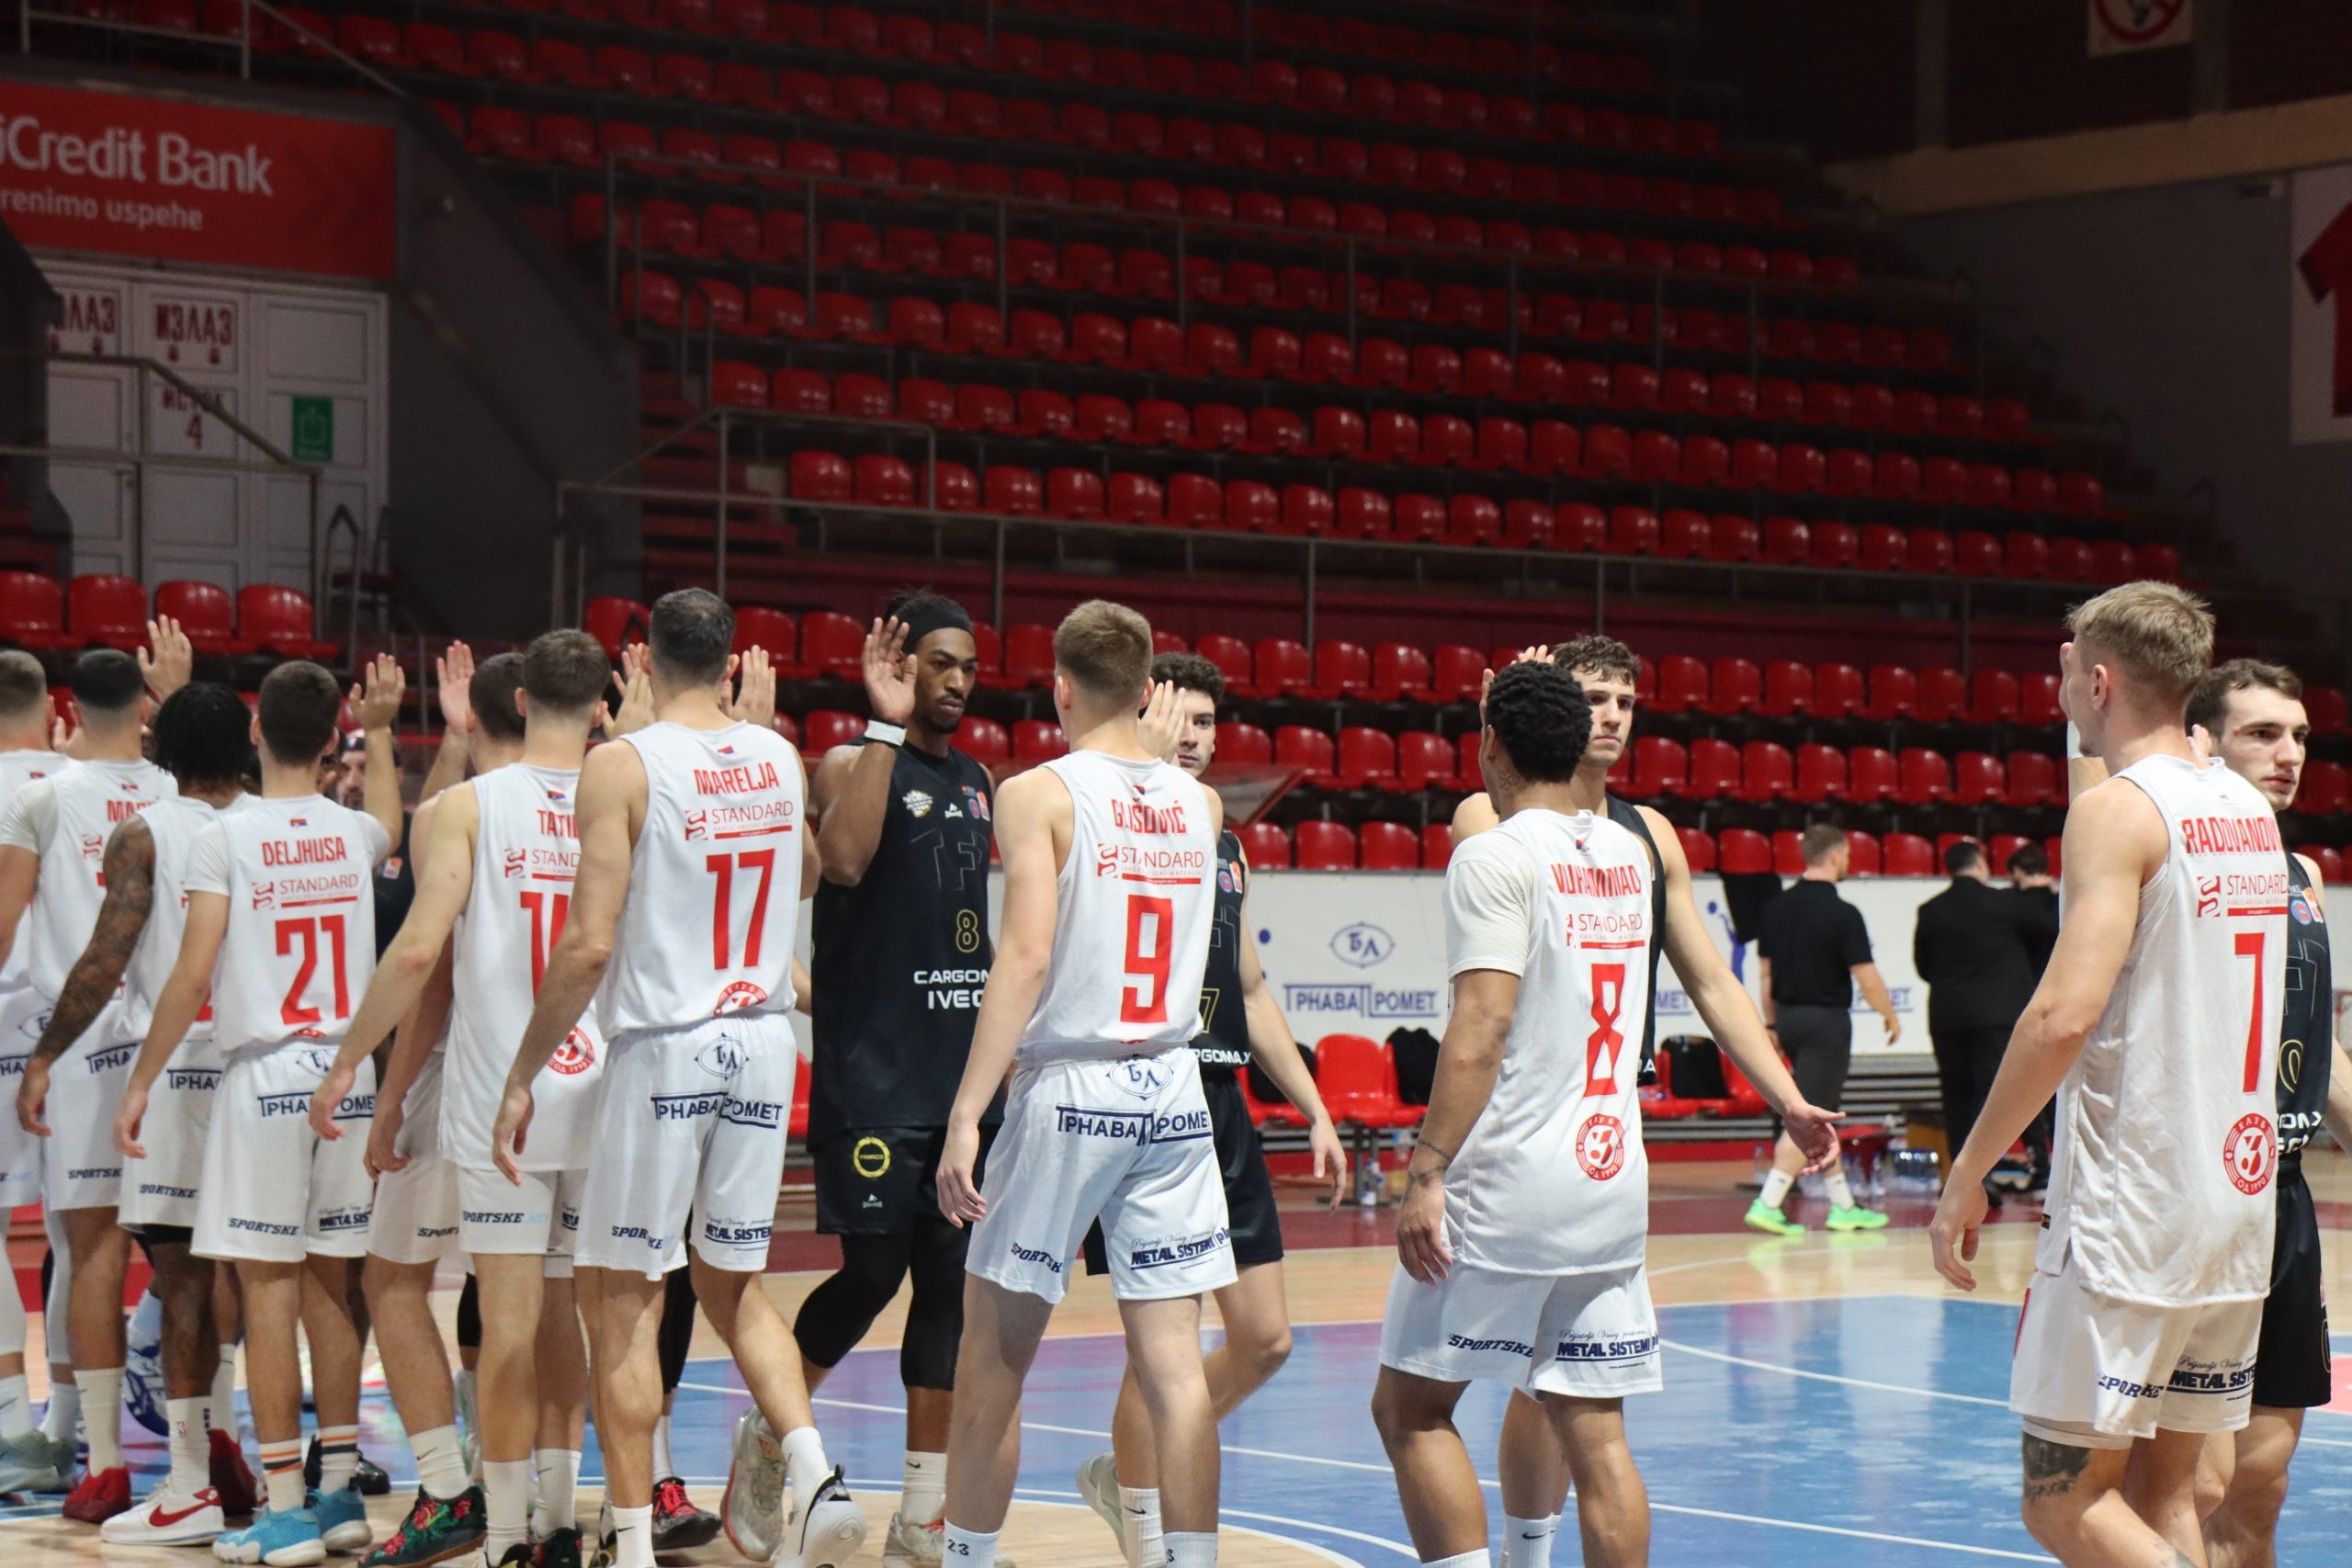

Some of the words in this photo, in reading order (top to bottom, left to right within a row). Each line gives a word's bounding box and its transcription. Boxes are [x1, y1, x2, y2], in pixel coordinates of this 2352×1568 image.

[158, 132, 274, 197] Bank
[0, 186, 99, 220] renimo
[106, 199, 203, 231] uspehe
[53, 293, 116, 334] ЛАЗ
[187, 414, 203, 451] 4
[694, 762, 779, 795] MARELJA
[712, 800, 794, 824] STANDARD
[262, 837, 347, 867] DELJHUSA
[531, 850, 581, 868] STAND
[1121, 846, 1204, 868] STNDARD
[279, 874, 359, 895] STANDARD
[2227, 874, 2287, 896] STANDARD
[707, 848, 775, 971] 17
[956, 909, 979, 953] 8
[276, 914, 351, 1025] 21
[1120, 894, 1174, 1024] 9
[2234, 931, 2266, 1093] 7
[1583, 963, 1625, 1098] 8
[68, 1168, 122, 1180] SPORTSK
[1601, 1164, 1618, 1179] 1990
[2251, 1177, 2267, 1192] 1990
[229, 1217, 300, 1235] SPORTSKE
[611, 1225, 663, 1249] SPORKE
[1011, 1242, 1063, 1274] SPORTSK
[1131, 1247, 1176, 1265] METAL
[1556, 1342, 1606, 1357] METAL
[2168, 1370, 2226, 1389] METAL
[947, 1539, 969, 1556] 23
